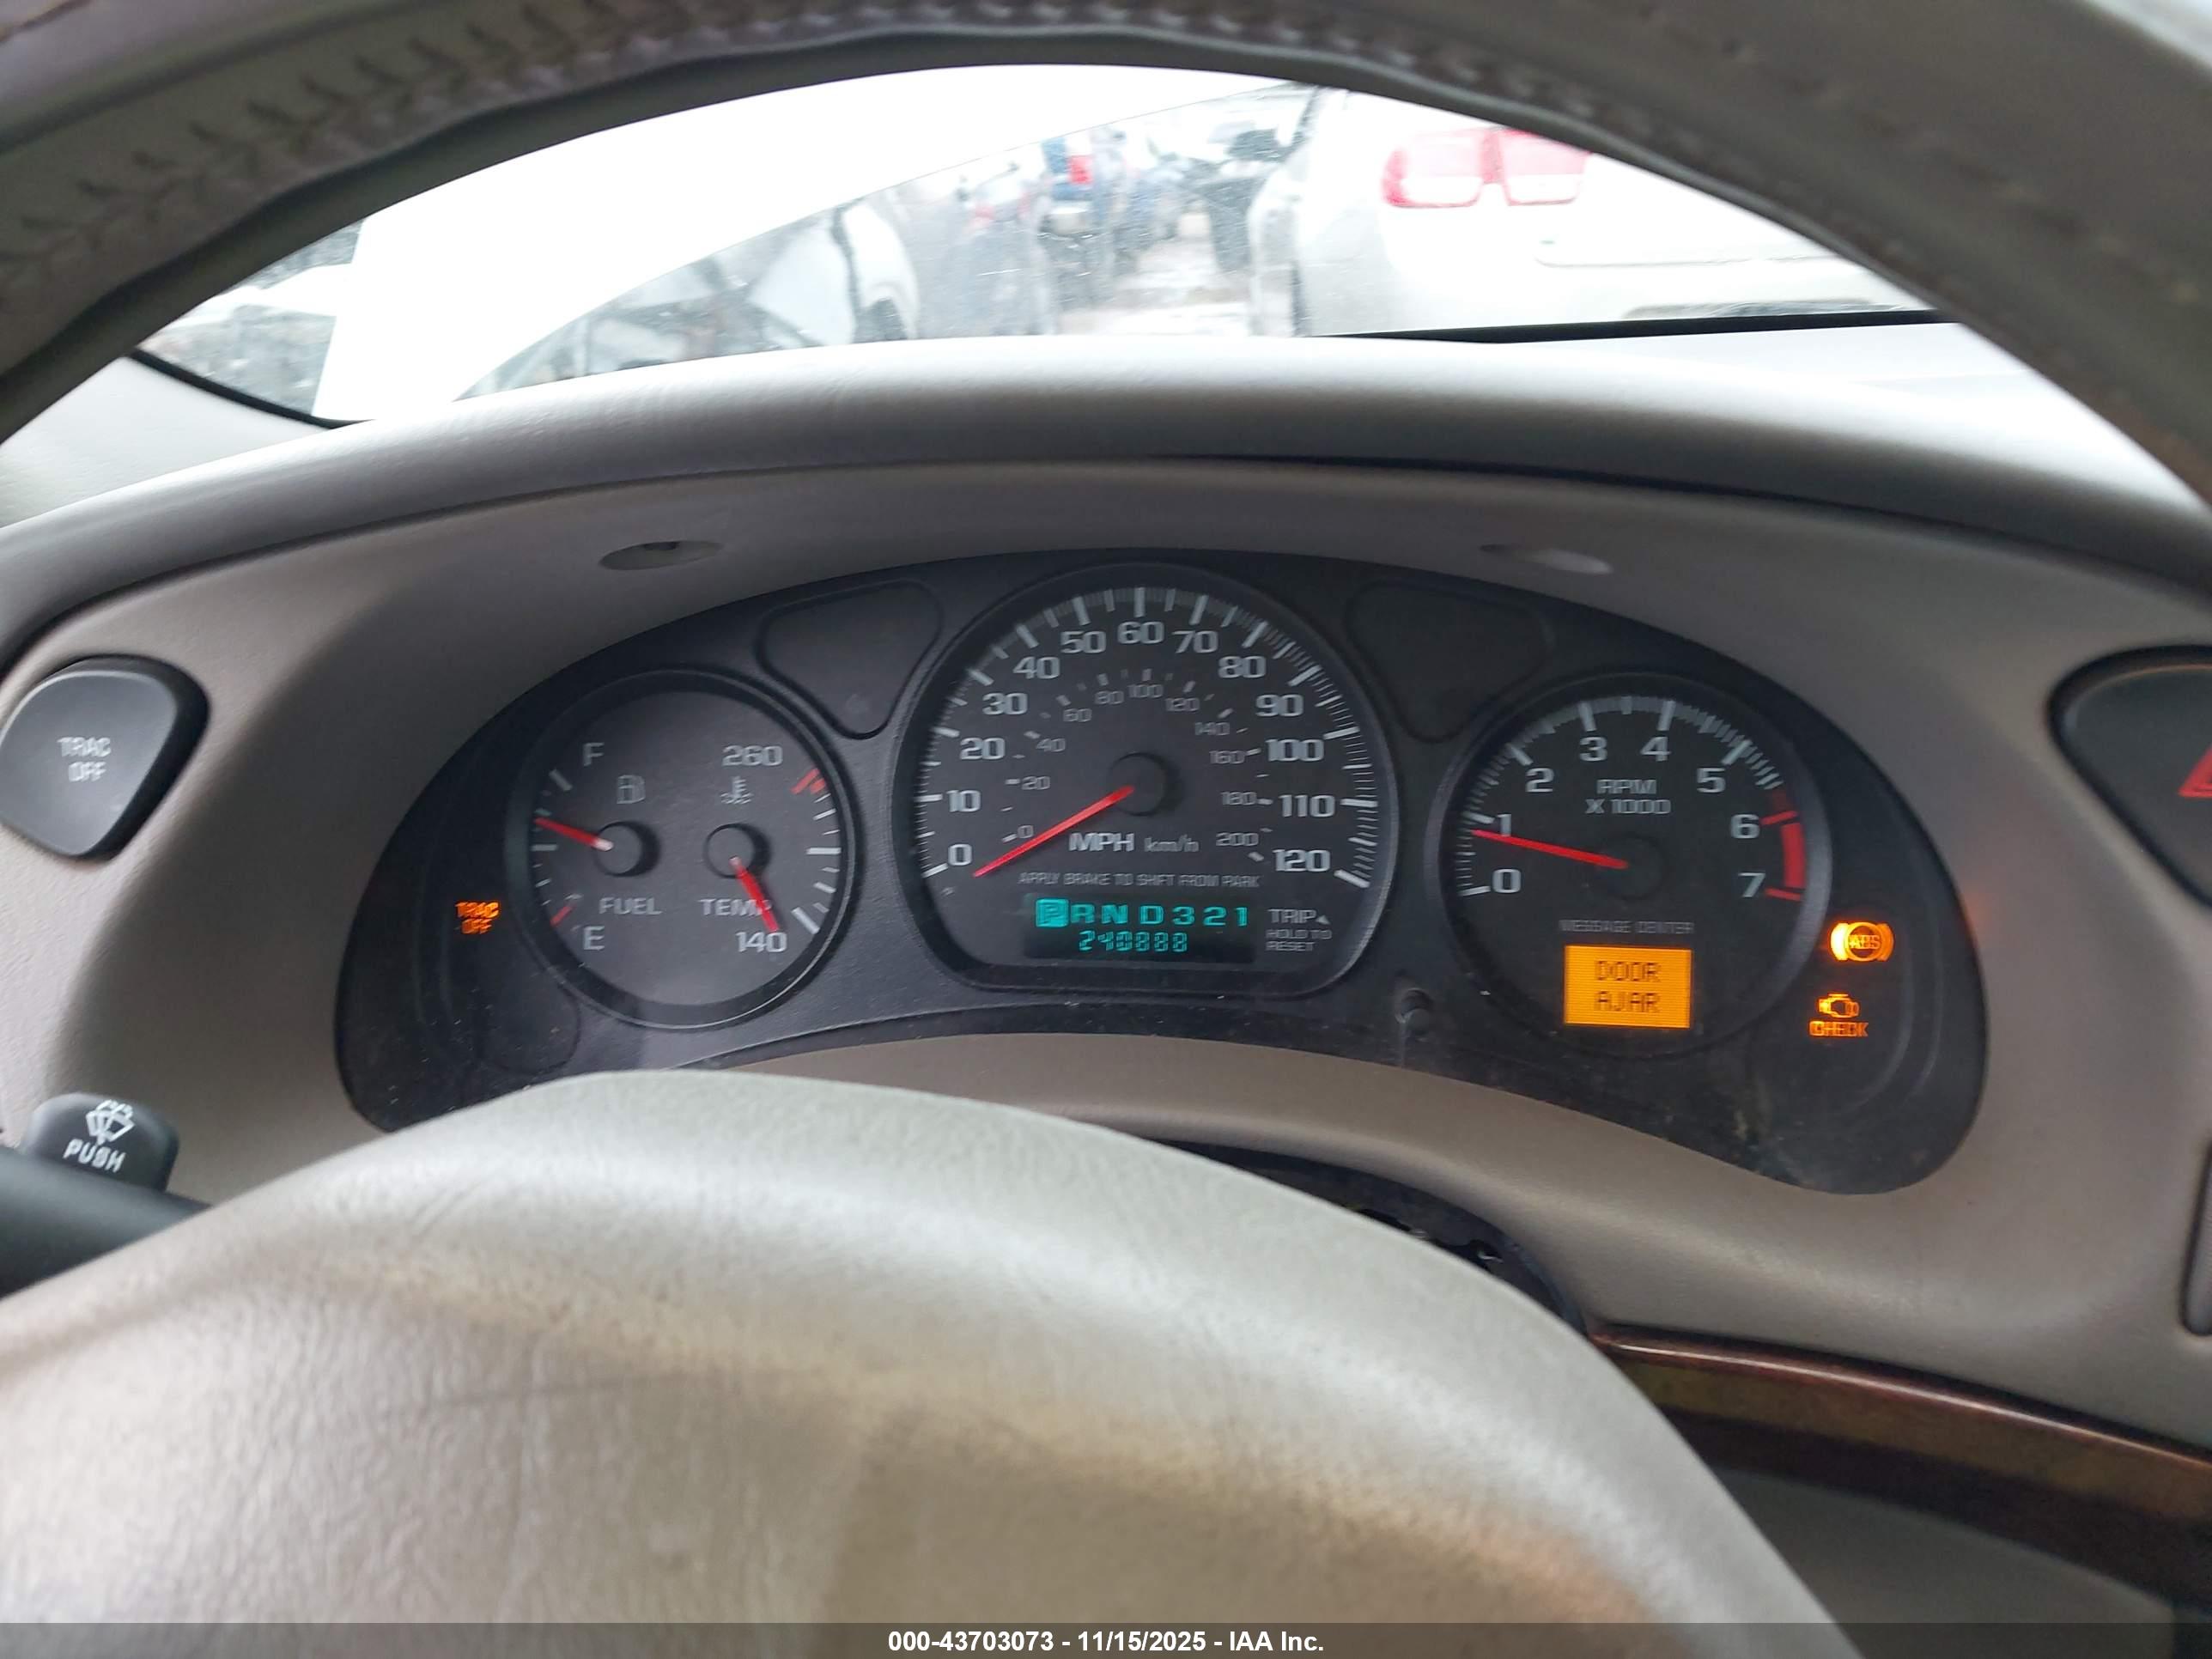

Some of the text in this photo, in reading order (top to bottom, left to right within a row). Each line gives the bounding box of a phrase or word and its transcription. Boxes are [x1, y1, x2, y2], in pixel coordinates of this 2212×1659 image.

[1060, 630, 1107, 653] 50
[1117, 621, 1164, 644] 60
[1171, 630, 1218, 653] 70
[1012, 656, 1061, 679] 40
[1218, 655, 1267, 679] 80
[1094, 690, 1124, 705] 80
[1128, 684, 1164, 698] 100
[982, 692, 1029, 715] 30
[1165, 697, 1200, 712] 120
[1255, 694, 1304, 717] 90
[1063, 708, 1092, 722] 60
[1194, 722, 1230, 736] 140
[58, 737, 112, 757] TRAC
[583, 742, 605, 767] F
[721, 745, 783, 767] 260
[959, 737, 1006, 760] 20
[1036, 738, 1066, 752] 40
[1265, 738, 1324, 762] 100
[1579, 736, 1607, 763] 3
[1640, 736, 1672, 762] 4
[1209, 750, 1245, 764] 160
[68, 762, 106, 782] OFF
[1021, 775, 1051, 790] 20
[1525, 768, 1555, 793] 2
[1697, 768, 1726, 794] 5
[1221, 791, 1257, 805] 180
[1596, 779, 1657, 795] RPM
[946, 790, 981, 812] 10
[1279, 794, 1335, 817] 110
[1584, 799, 1672, 815] X 1000
[1018, 824, 1034, 839] 0
[1497, 813, 1512, 837] 1
[1730, 813, 1761, 840] 6
[1069, 832, 1200, 853] MPH km/h
[1215, 832, 1259, 847] 200
[948, 843, 973, 866] 0
[1273, 849, 1330, 872] 120
[1017, 872, 1263, 888] APPLY BRAKE TO SHIFT FROM PARK
[1492, 868, 1522, 894] 0
[1737, 872, 1766, 898] 7
[599, 896, 663, 915] FUEL
[1267, 908, 1316, 923] TRIP
[583, 926, 605, 951] E
[735, 932, 787, 953] 140
[1266, 929, 1333, 940] HOLD TO
[1266, 940, 1316, 951] RESET
[1848, 934, 1881, 950] ABS
[1595, 960, 1662, 982] DOOR
[1595, 991, 1661, 1013] AJAR
[1809, 1020, 1869, 1037] CHECK
[63, 1138, 127, 1173] PUSH
